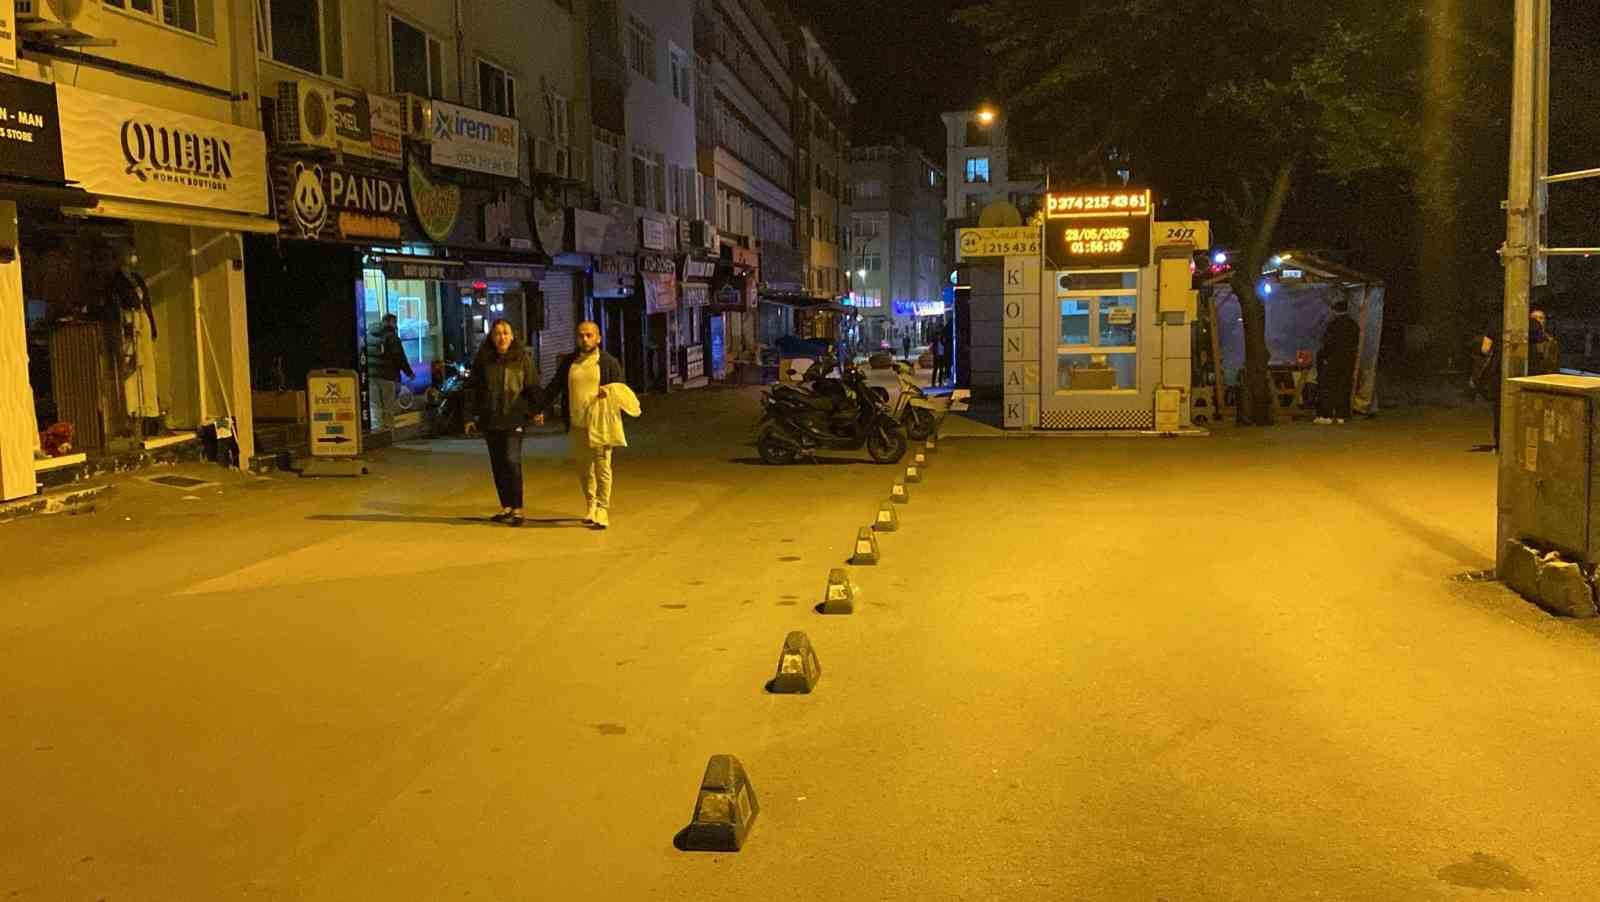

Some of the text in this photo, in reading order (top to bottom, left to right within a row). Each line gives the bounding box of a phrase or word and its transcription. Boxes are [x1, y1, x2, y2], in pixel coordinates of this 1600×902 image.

[18, 110, 43, 128] MAN
[456, 109, 514, 146] iremnet
[6, 128, 33, 143] STORE
[120, 119, 232, 183] QUEEN
[329, 171, 408, 214] PANDA
[1058, 196, 1083, 209] 374
[1084, 196, 1110, 208] 215
[1111, 195, 1128, 207] 43
[1129, 194, 1145, 207] 61
[1167, 228, 1195, 241] 24/7
[1006, 269, 1020, 418] KONAK
